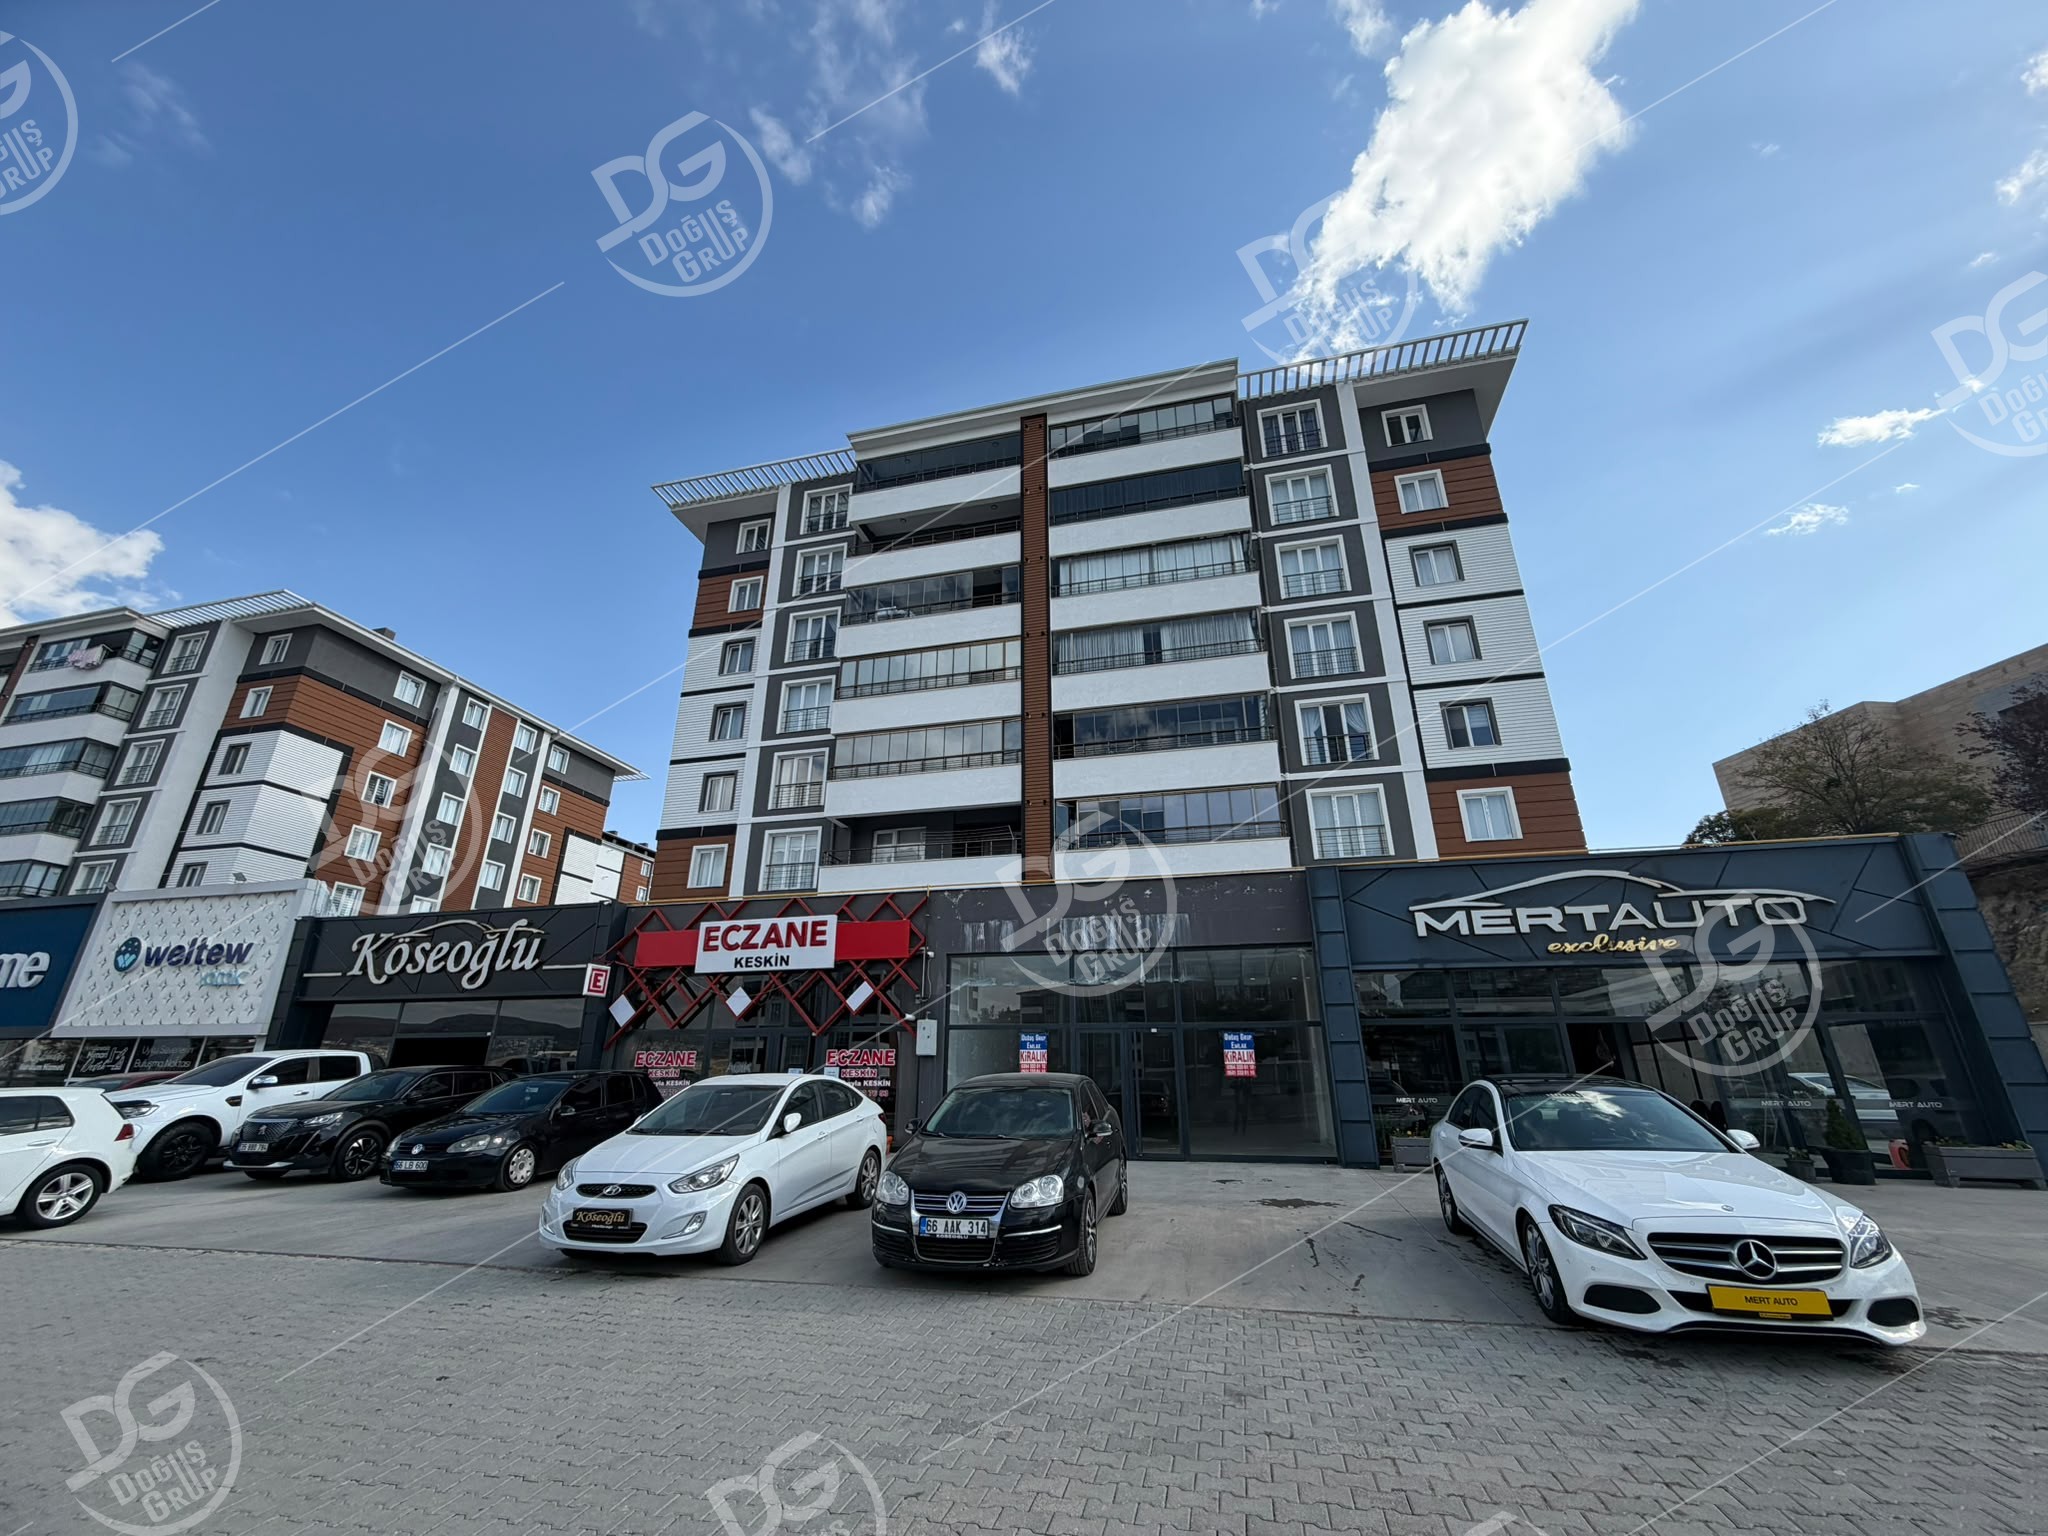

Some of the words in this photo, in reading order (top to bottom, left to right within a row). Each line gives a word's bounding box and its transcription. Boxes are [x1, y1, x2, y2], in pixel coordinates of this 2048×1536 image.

[703, 920, 828, 952] ECZANE
[1547, 934, 1680, 955] exclusive
[144, 938, 253, 966] weltew
[347, 919, 541, 989] Köseoğlu
[734, 952, 790, 968] KESKİN
[634, 1050, 698, 1068] ECZANE
[828, 1049, 896, 1066] ECZANE
[841, 1067, 877, 1078] KESKİN
[926, 1219, 938, 1233] 66
[944, 1220, 962, 1234] AAK
[968, 1221, 986, 1235] 314
[1744, 1295, 1770, 1305] MERT
[1773, 1297, 1798, 1306] AUTO
